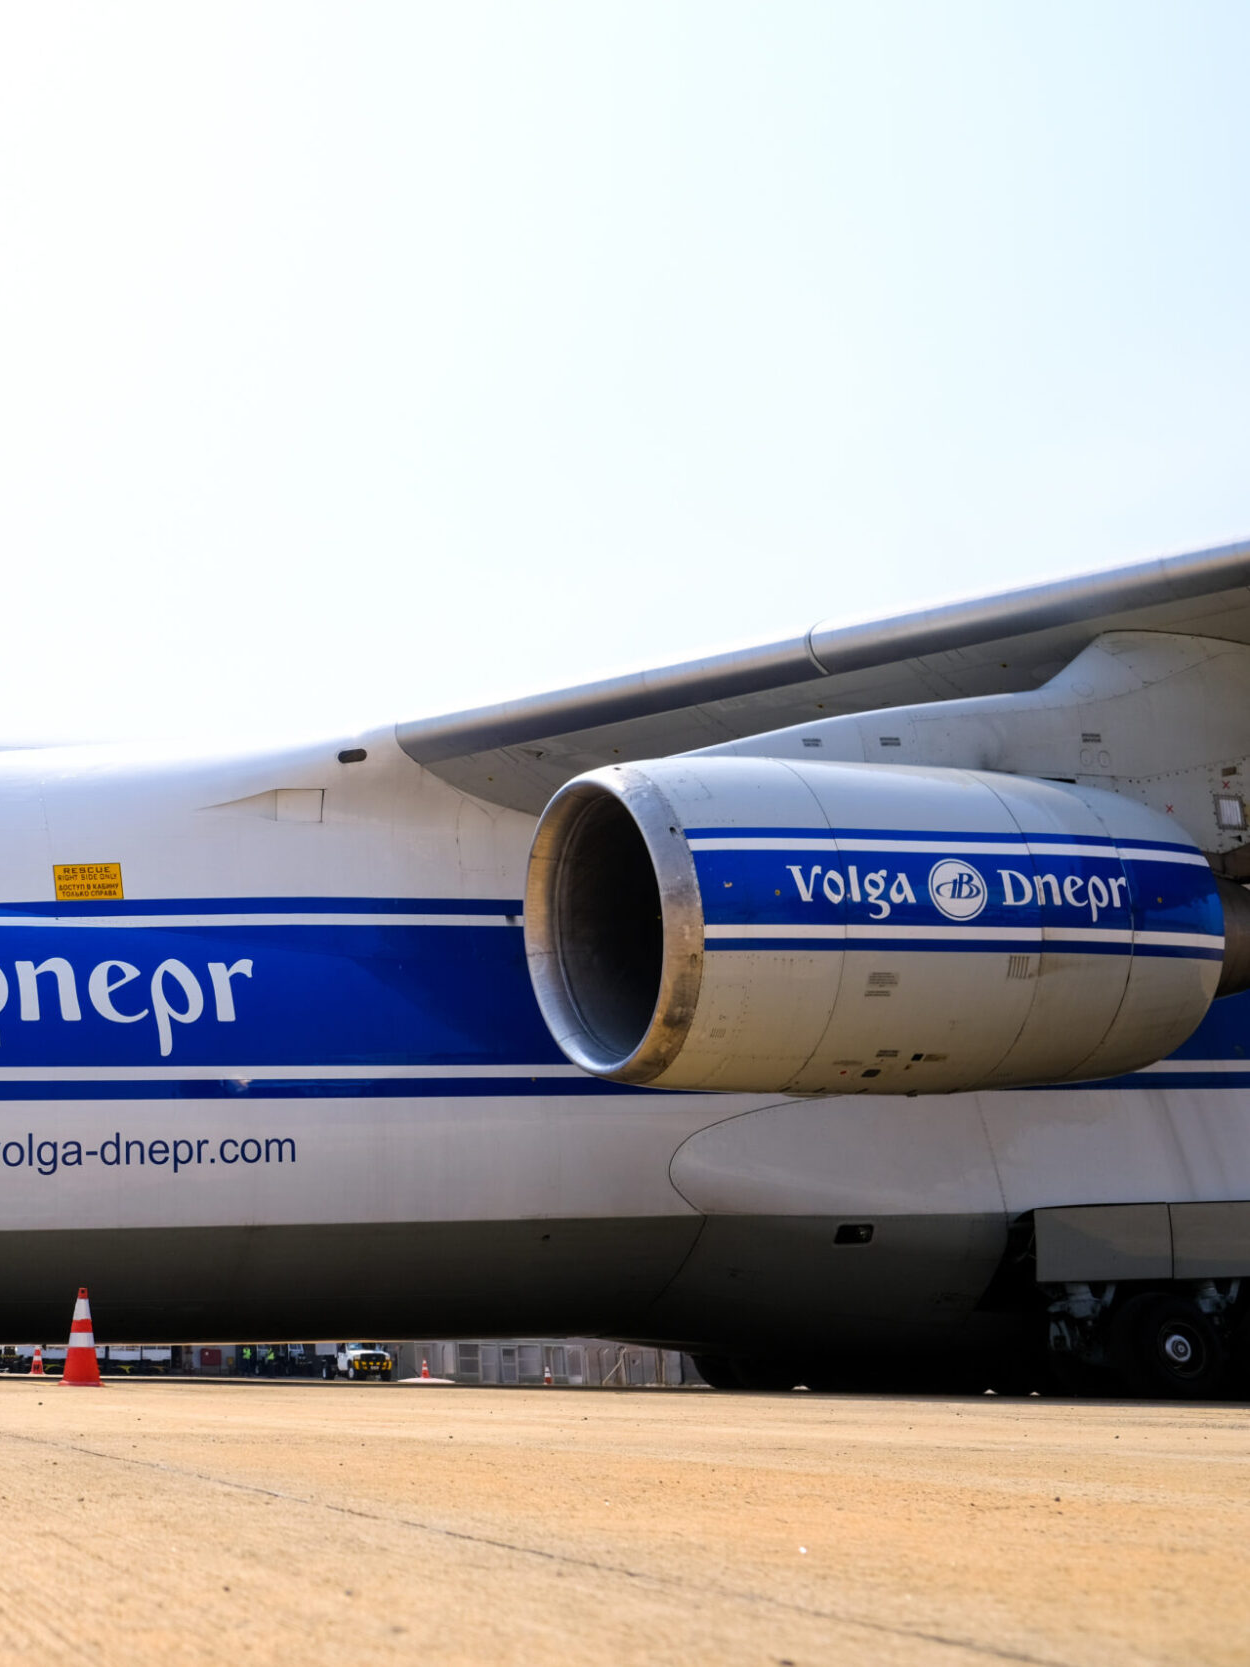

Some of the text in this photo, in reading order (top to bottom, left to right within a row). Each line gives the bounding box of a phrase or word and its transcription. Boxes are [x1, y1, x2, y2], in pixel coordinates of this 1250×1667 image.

[63, 866, 111, 874] RESCUE
[786, 865, 917, 919] Volga
[997, 869, 1127, 922] Dnepr
